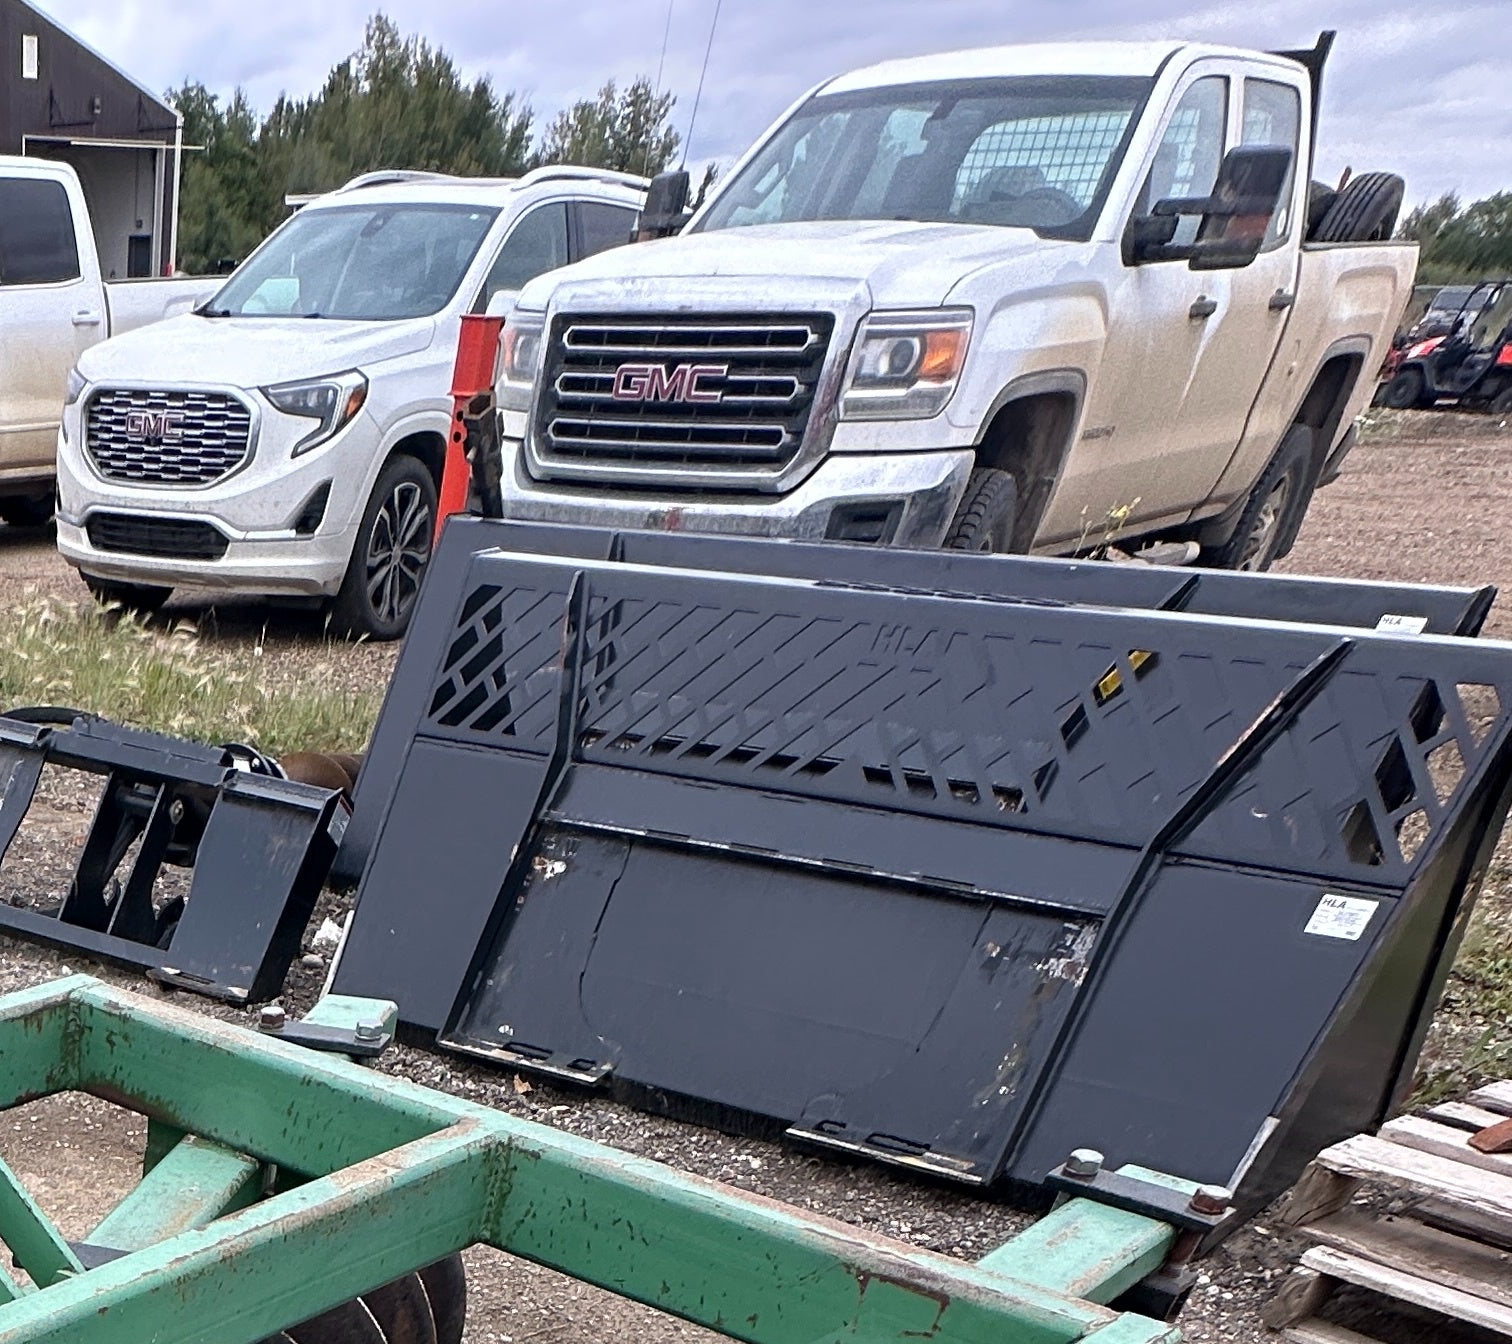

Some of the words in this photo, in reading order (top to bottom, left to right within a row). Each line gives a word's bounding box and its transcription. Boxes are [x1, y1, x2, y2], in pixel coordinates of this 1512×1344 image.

[612, 364, 728, 402] GMC
[127, 408, 185, 438] GMC
[1322, 899, 1347, 909] HLA
